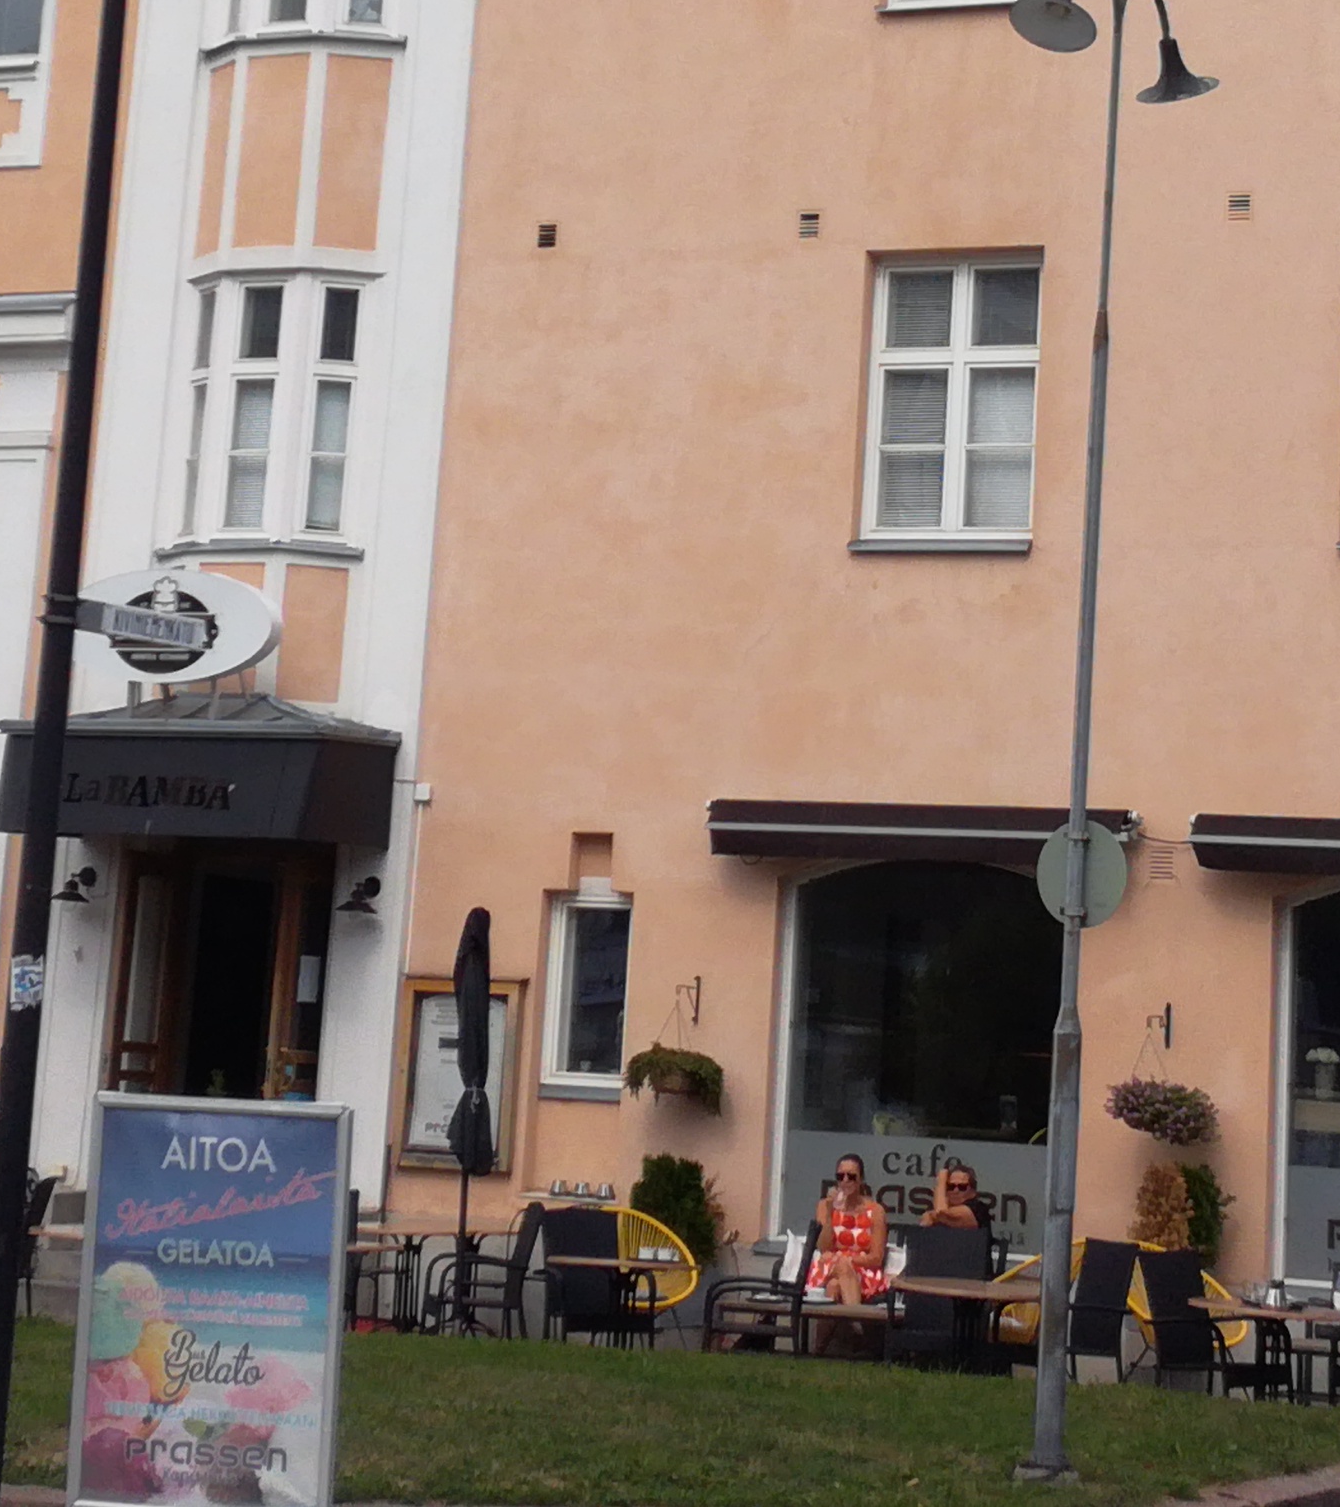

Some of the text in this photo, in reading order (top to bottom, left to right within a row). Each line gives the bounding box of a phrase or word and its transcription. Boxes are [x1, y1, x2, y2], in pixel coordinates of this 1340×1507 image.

[160, 1135, 277, 1173] AITOA
[157, 1237, 275, 1268] GELATOA
[163, 1340, 266, 1398] Gelato
[125, 1438, 288, 1473] prassen
